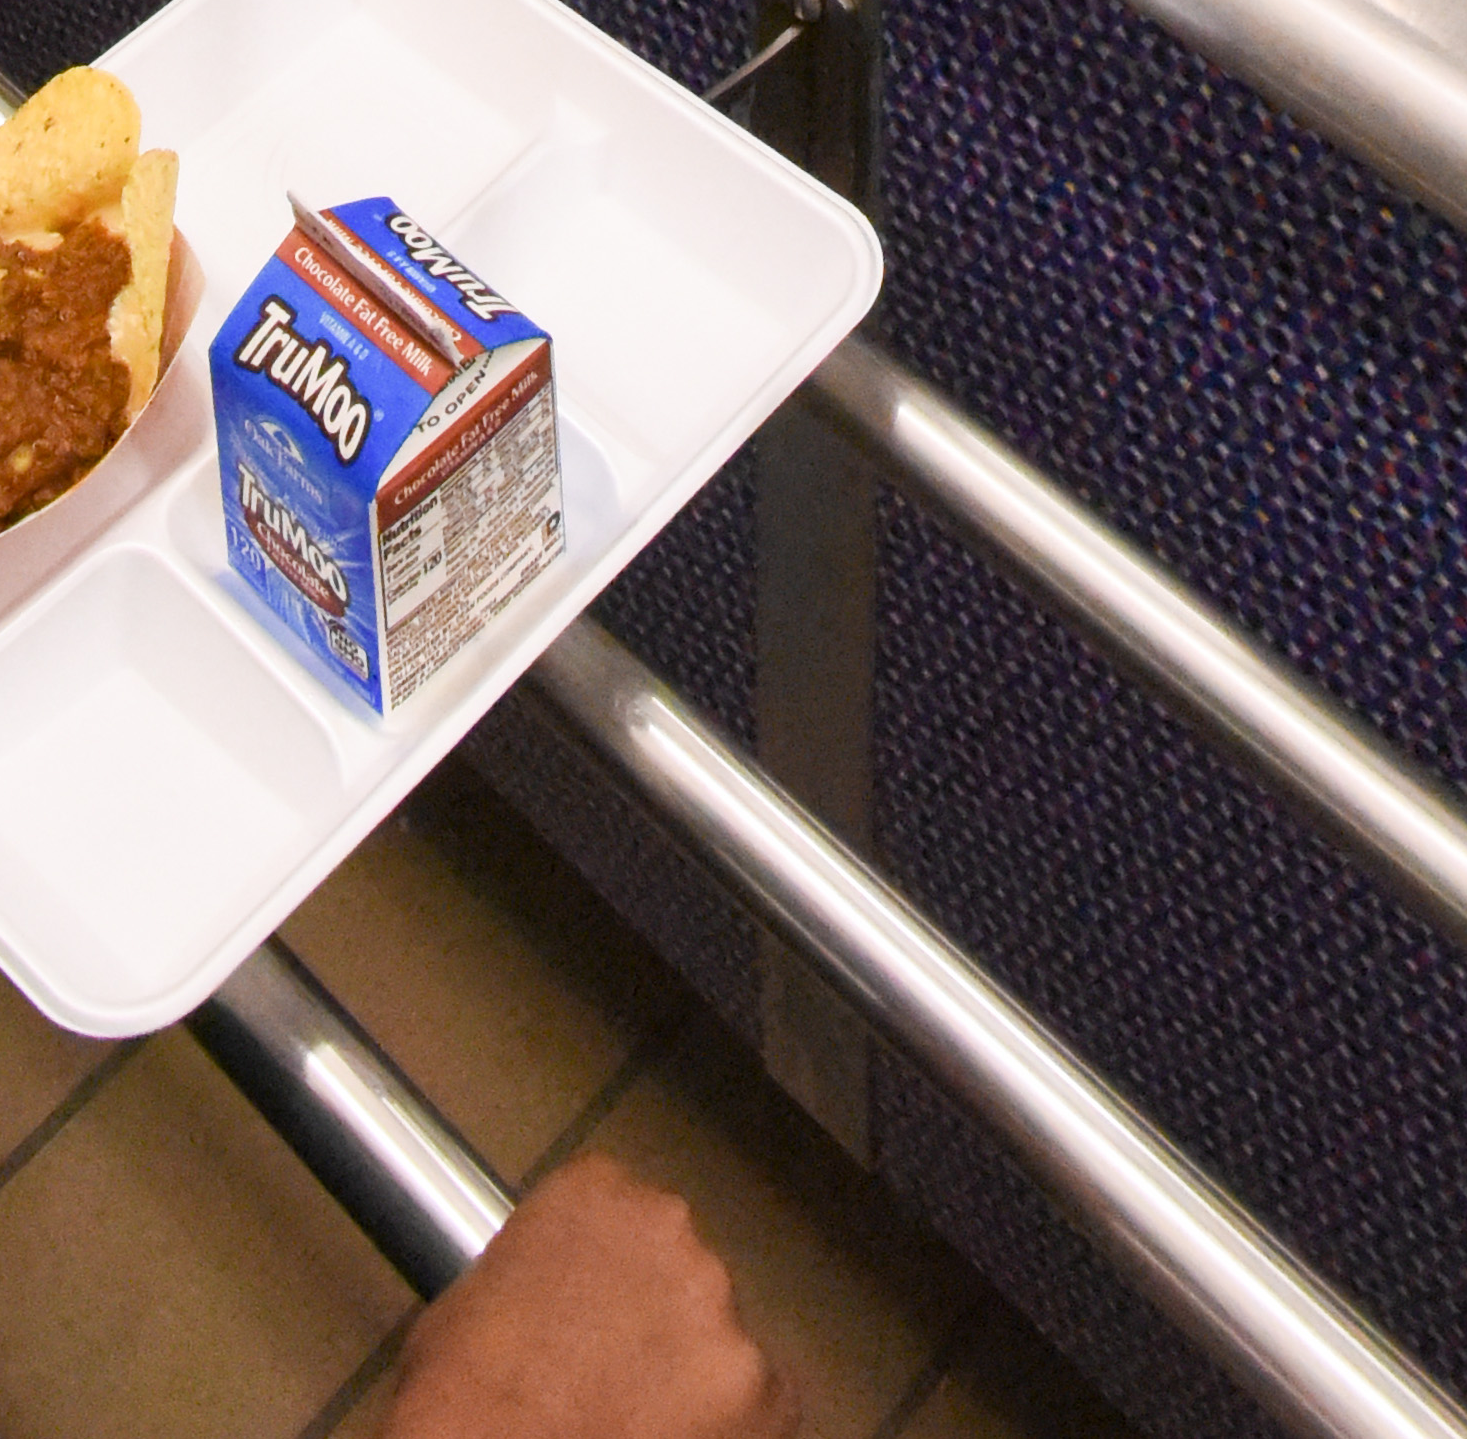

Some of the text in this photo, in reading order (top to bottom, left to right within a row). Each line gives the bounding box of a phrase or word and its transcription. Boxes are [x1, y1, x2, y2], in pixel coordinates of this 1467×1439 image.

[293, 246, 356, 308] Chocolate
[352, 296, 378, 326] Fat
[373, 315, 404, 351] Free
[401, 341, 433, 377] Milk
[389, 214, 521, 320] TruMoo
[238, 301, 367, 460] TruMoo
[416, 369, 486, 433] TO OPEN
[394, 370, 539, 505] Chocolate Fat Free Milk
[238, 463, 348, 603] TruMoo
[256, 521, 330, 599] Chocolate
[382, 496, 438, 546] Nutrition
[384, 525, 422, 561] Facts
[423, 550, 443, 575] 120
